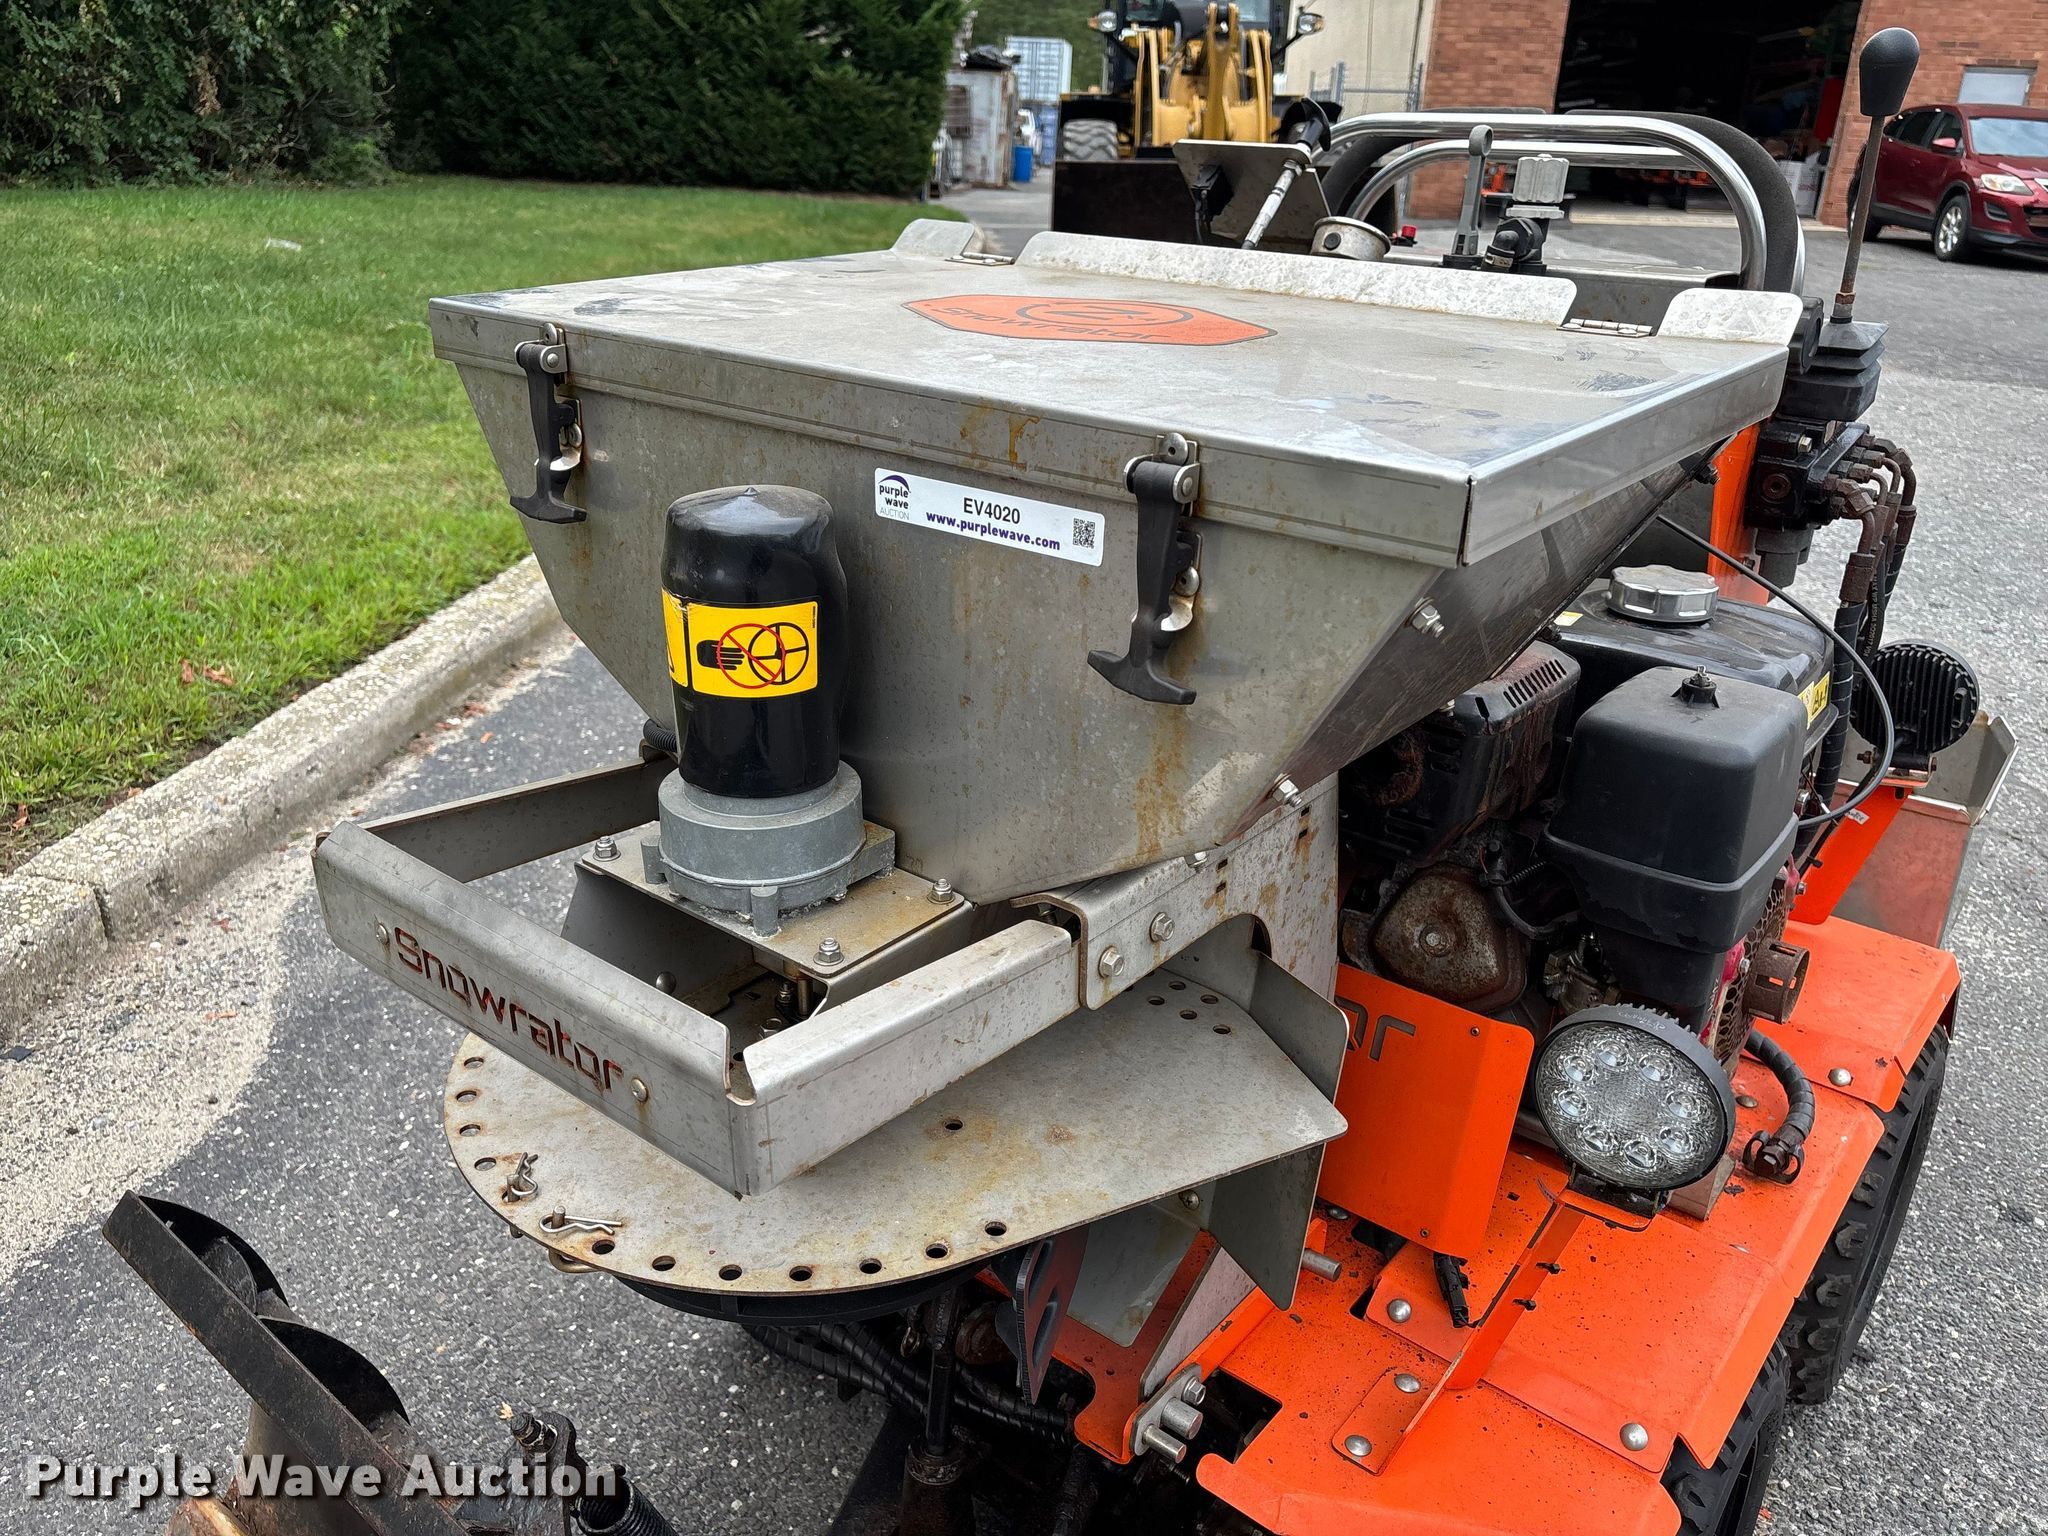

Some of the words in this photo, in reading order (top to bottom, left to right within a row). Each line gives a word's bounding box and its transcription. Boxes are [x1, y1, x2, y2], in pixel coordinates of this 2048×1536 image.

[879, 484, 909, 498] purple
[885, 497, 909, 509] wave
[963, 497, 1021, 525] EV4020
[880, 507, 910, 521] AUCTION
[926, 511, 1061, 551] www.purplewave.com
[394, 926, 625, 1093] Snowrator
